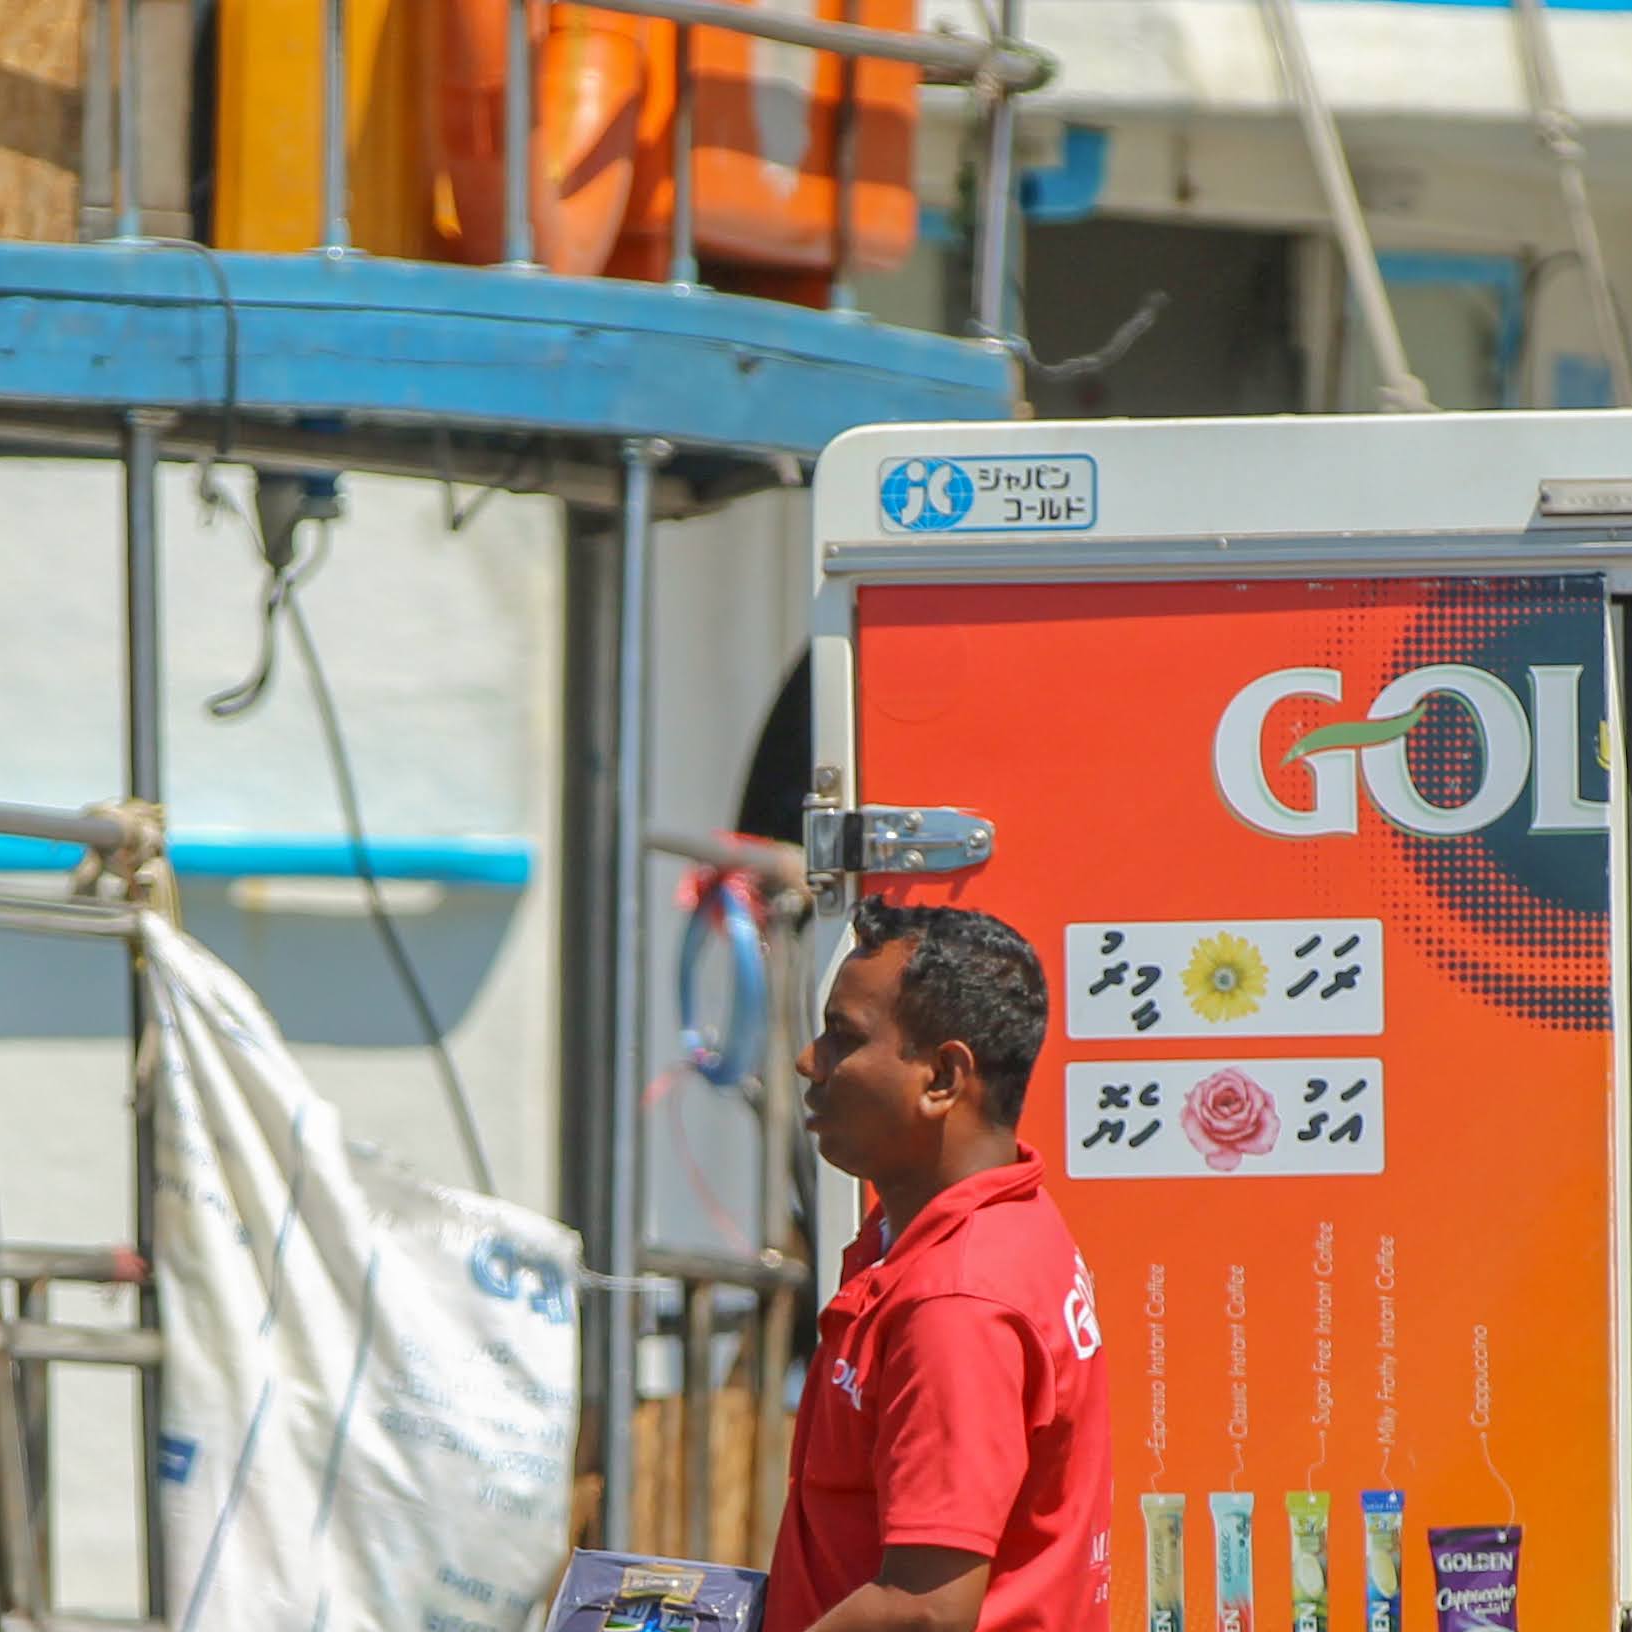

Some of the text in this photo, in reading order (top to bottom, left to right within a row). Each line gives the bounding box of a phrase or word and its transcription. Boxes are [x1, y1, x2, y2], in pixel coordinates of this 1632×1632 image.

[978, 464, 1071, 491] ジャパン
[1003, 497, 1086, 521] コールド
[1313, 1221, 1334, 1277] Coffee
[1375, 1234, 1396, 1291] Coffee
[1144, 1263, 1166, 1318] Coffee
[1438, 1551, 1515, 1574] GOLDEN
